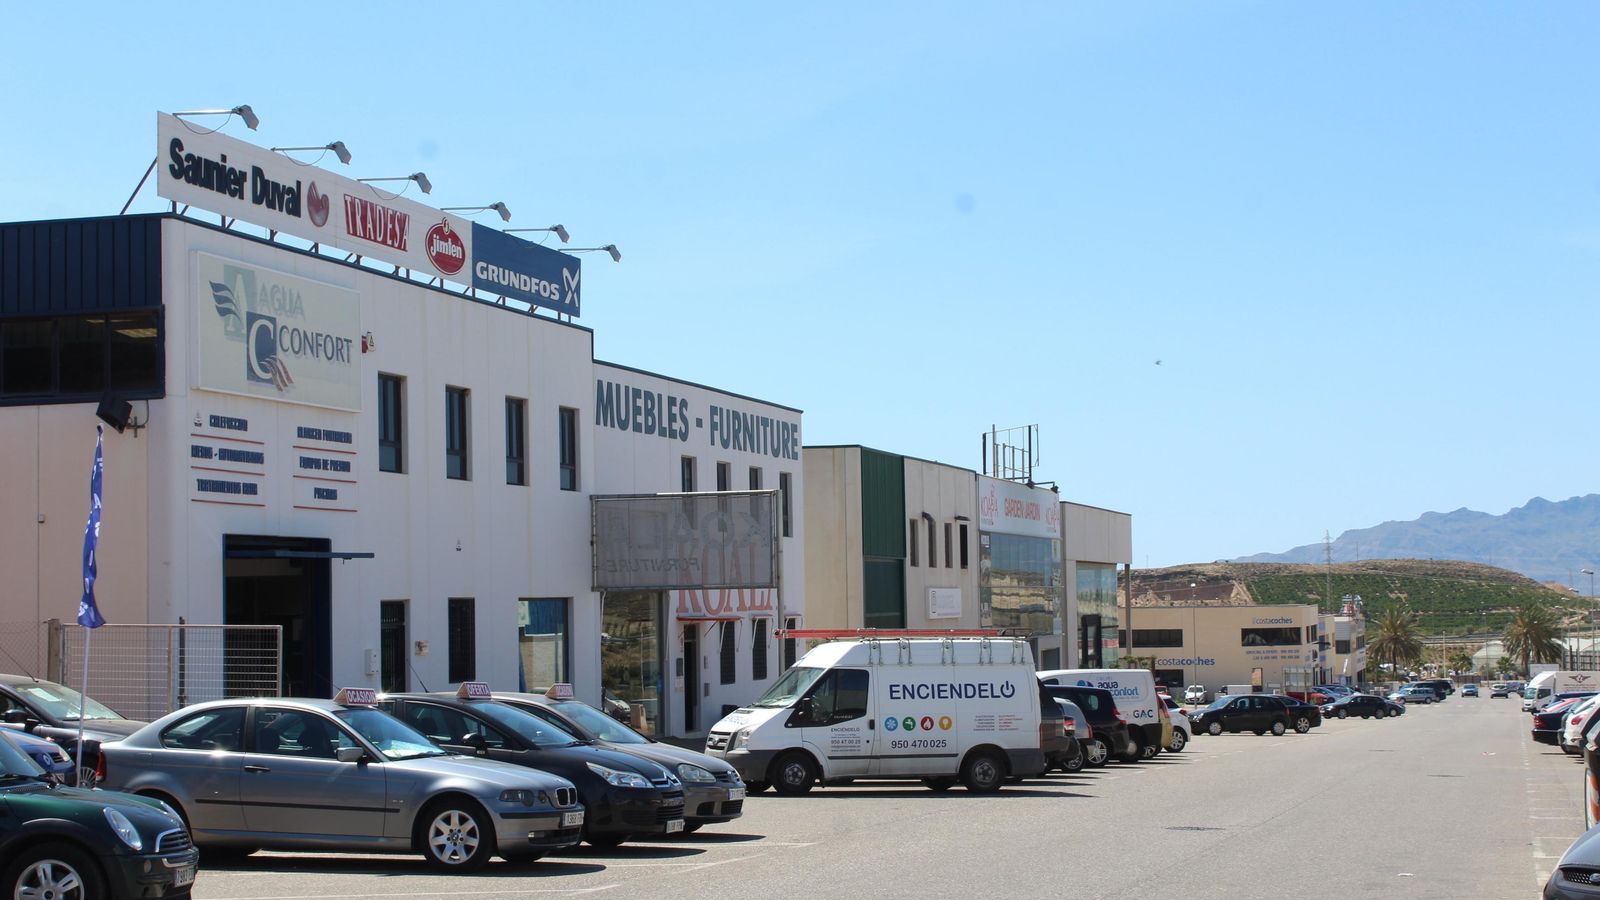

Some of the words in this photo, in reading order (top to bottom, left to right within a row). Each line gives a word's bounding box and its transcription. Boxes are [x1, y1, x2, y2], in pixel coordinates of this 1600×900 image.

[169, 138, 247, 200] Saunier
[252, 165, 301, 218] Duval
[344, 194, 410, 252] TRADESA
[431, 234, 463, 259] jimten
[476, 261, 560, 301] GRUNDFOS
[258, 282, 305, 319] AGUA
[279, 325, 352, 363] CONFORT
[596, 379, 689, 442] MUEBLES
[710, 405, 798, 461] FURNITURE
[468, 682, 491, 697] OFERTA
[889, 681, 1015, 700] ENCIENDELO
[1097, 681, 1118, 689] aqua
[891, 740, 909, 749] 950
